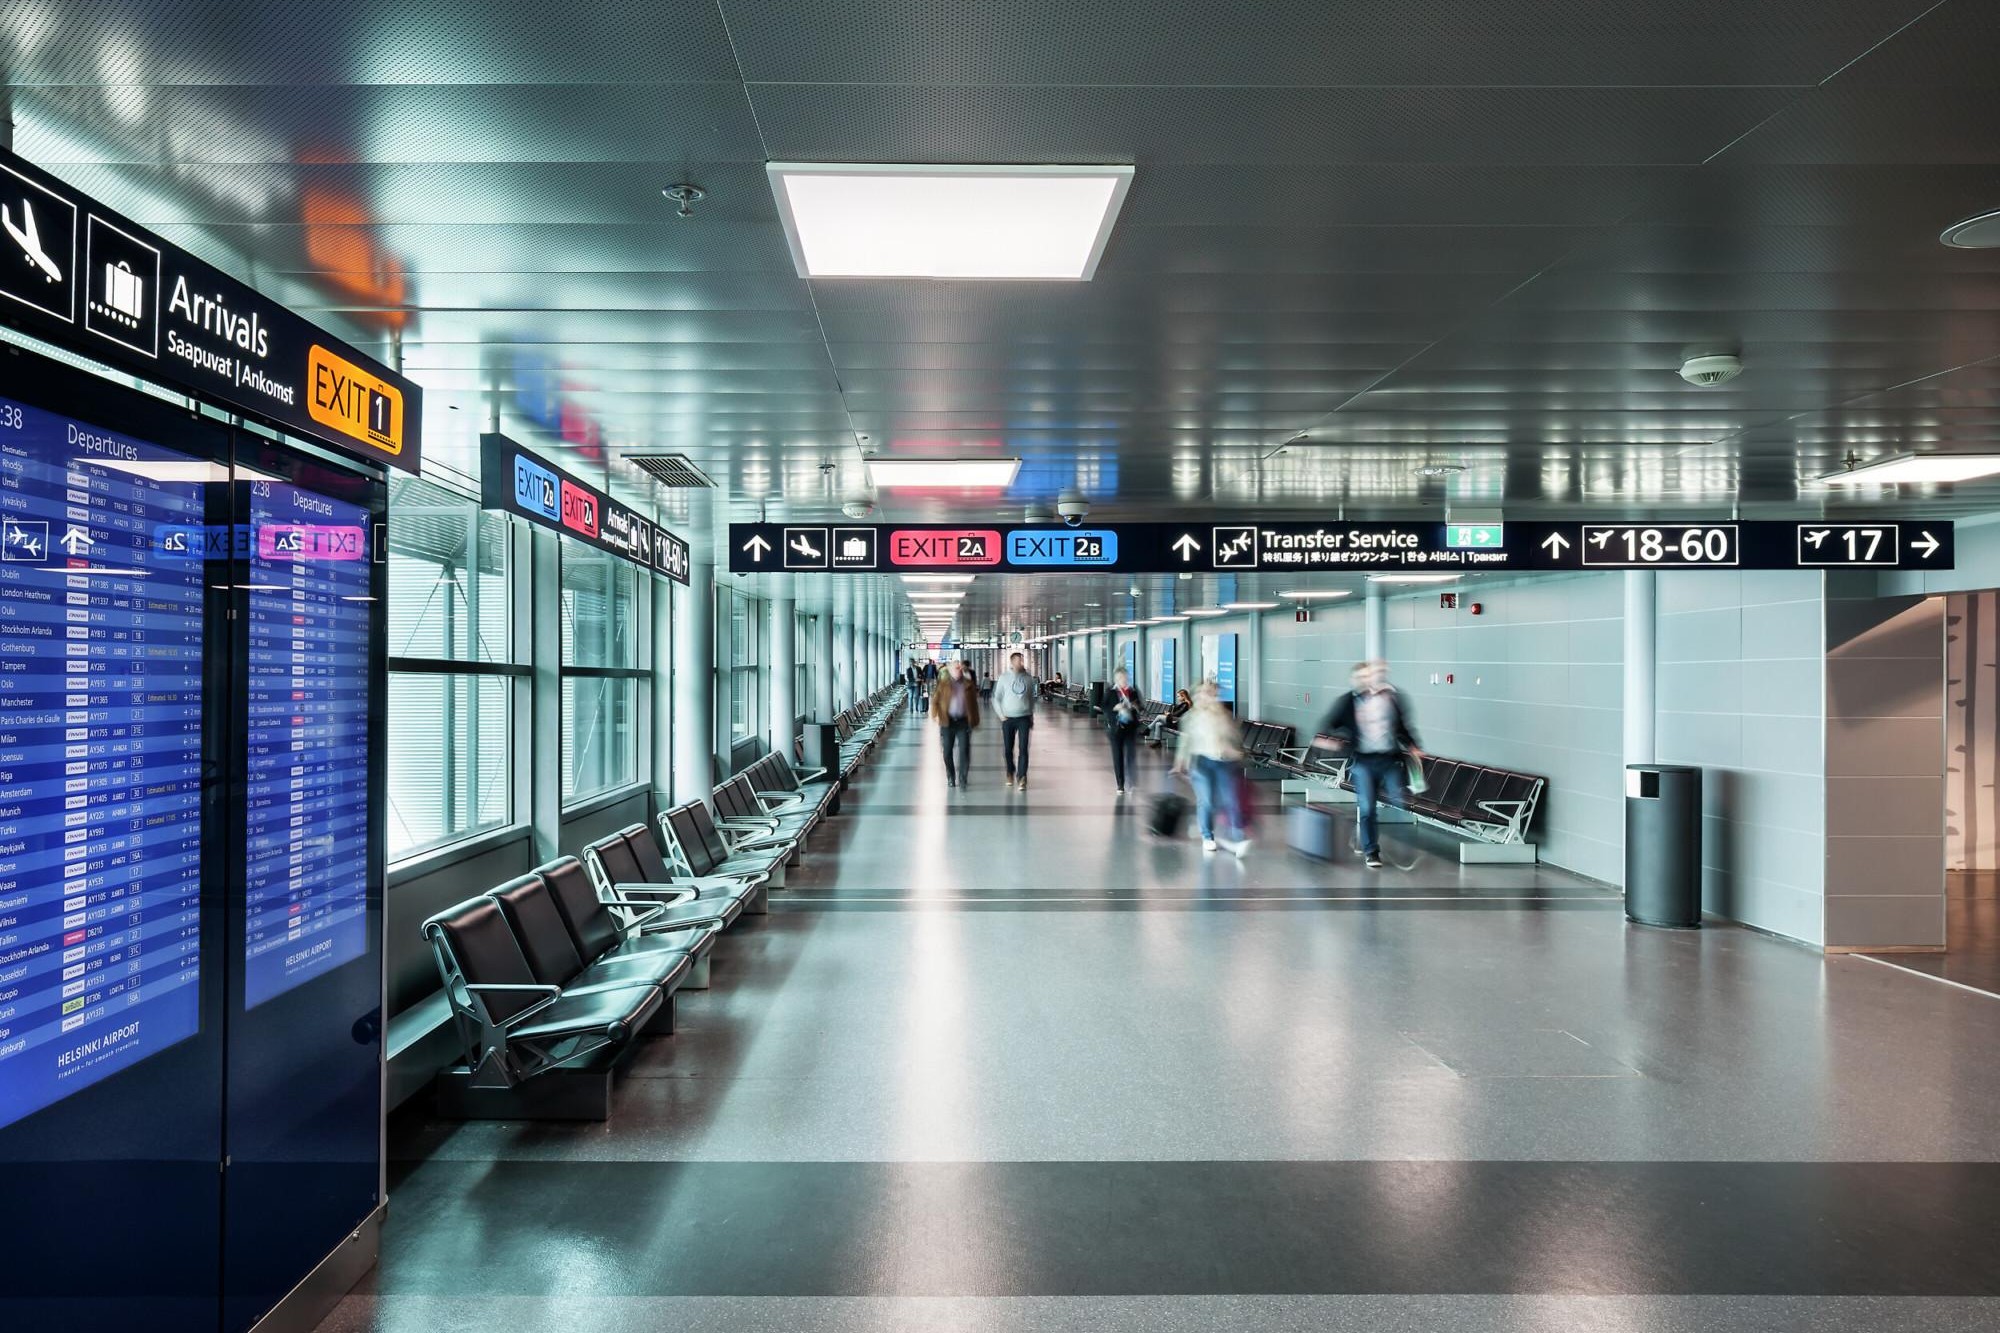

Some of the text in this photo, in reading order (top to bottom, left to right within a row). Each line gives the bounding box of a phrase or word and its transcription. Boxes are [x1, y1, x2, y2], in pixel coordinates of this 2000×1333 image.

[169, 276, 267, 357] Arrivals
[169, 330, 294, 404] Saapuvat Ankomst
[316, 363, 383, 430] EXIT 1
[67, 424, 138, 461] Departures
[2, 445, 27, 457] Destination
[2, 477, 19, 488] Umeå
[519, 468, 554, 507] EXIT 2B
[2, 496, 27, 508] Jyväskylä
[294, 491, 332, 516] Departures
[565, 490, 593, 528] EXIT 2A
[1262, 530, 1418, 548] Transfer Service
[1842, 530, 1882, 560] 17
[899, 538, 984, 557] EXIT 2A
[1015, 538, 1100, 557] EXIT 2B
[1621, 530, 1727, 561] 18-60
[662, 537, 680, 574] 18-60
[1430, 552, 1459, 563] 서비스
[1469, 552, 1507, 563] Транзит
[2, 569, 19, 580] Dublin
[2, 587, 23, 598] London
[25, 589, 51, 601] Heathrow
[2, 606, 15, 615] Oulu
[2, 624, 30, 634] Stockholm
[31, 625, 52, 635] Arlanda
[2, 644, 35, 654] Gothenburg
[1, 662, 26, 671] Tampere
[1, 680, 13, 688] Oslo
[1, 698, 33, 706] Manchester
[1, 716, 14, 725] Paris
[16, 716, 35, 724] Charles
[36, 715, 44, 723] de
[45, 714, 60, 723] Gaulle
[1, 735, 16, 743] Milan
[1, 754, 23, 762] Joensuu
[1, 772, 13, 782] Riga
[1, 789, 32, 798] Amsterdam
[0, 807, 21, 816] Munich
[0, 826, 16, 835] Turku
[0, 842, 25, 855] Reykjavik
[0, 863, 16, 873] Rome
[0, 881, 16, 891] Vaasa
[0, 894, 28, 908] Rovaniemi
[28, 942, 49, 955] Arlanda
[286, 948, 310, 966] HELSINKI
[311, 939, 332, 956] AIRPORT
[0, 1028, 10, 1039] iga
[0, 1038, 26, 1056] dinburgh
[58, 1021, 140, 1068] HELSINKI AIRPORT
